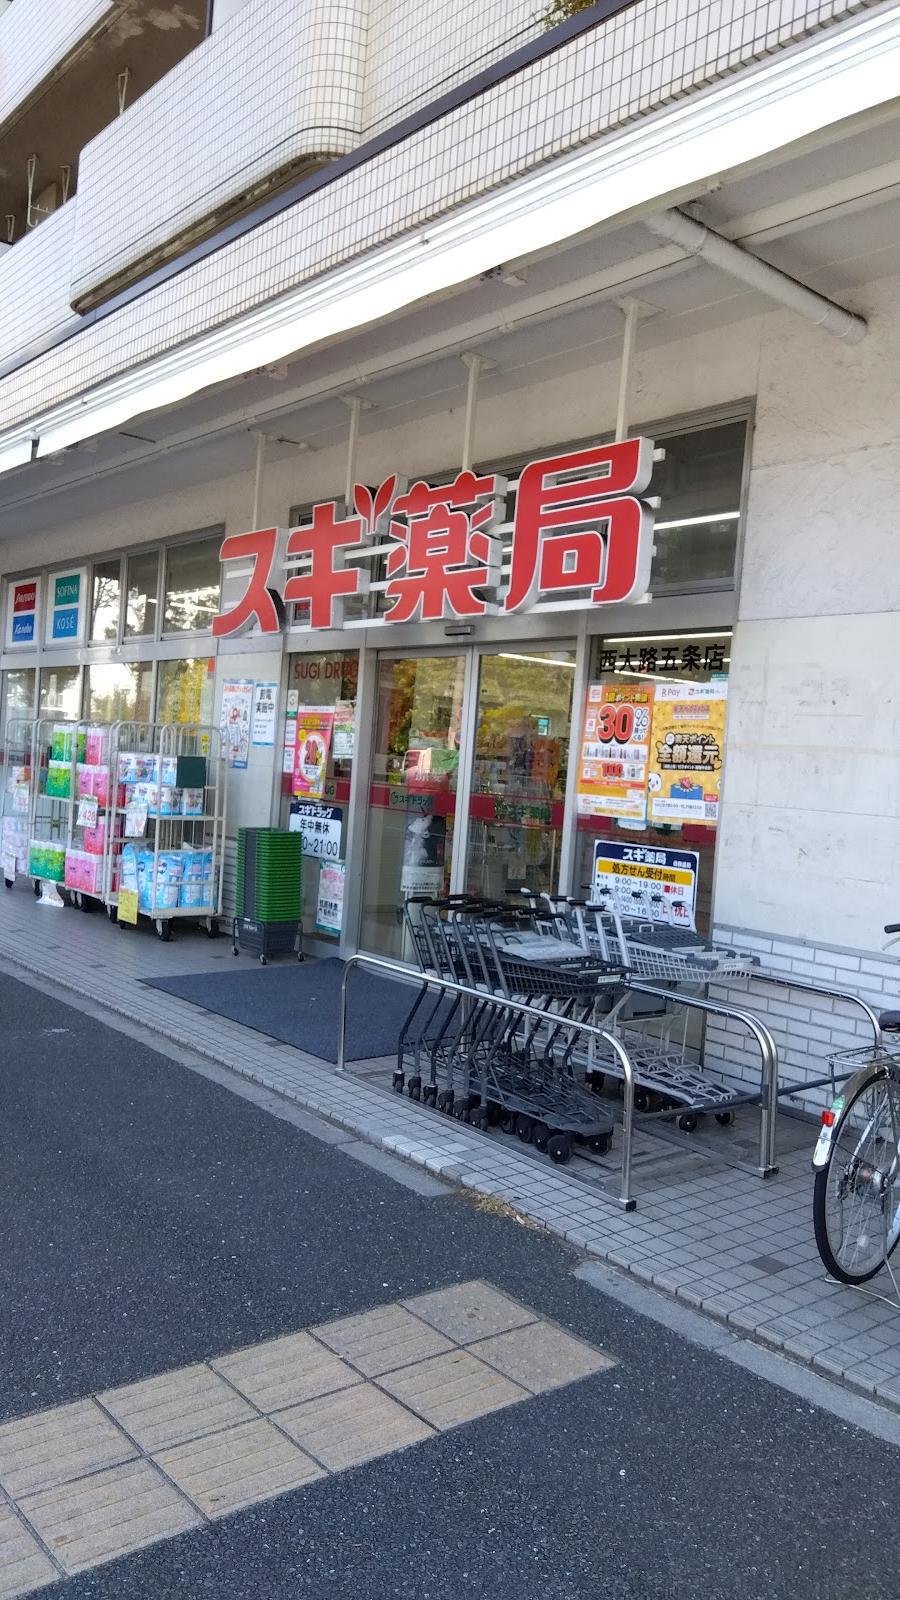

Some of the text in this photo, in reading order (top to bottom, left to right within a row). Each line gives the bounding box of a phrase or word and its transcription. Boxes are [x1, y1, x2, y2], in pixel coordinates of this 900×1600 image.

[212, 436, 652, 637] スギ薬局
[56, 584, 78, 598] SOFINA
[56, 614, 75, 630] KOSÉ
[600, 643, 725, 673] 西大路五条店
[294, 662, 320, 680] SUGI
[674, 733, 715, 745] 楽天ポイント
[657, 744, 719, 765] 全額還元
[299, 804, 334, 818] スギドラッグ
[300, 818, 330, 836] 年中無休
[622, 848, 667, 865] スギ薬局
[612, 862, 676, 883] 処方せん受付時間
